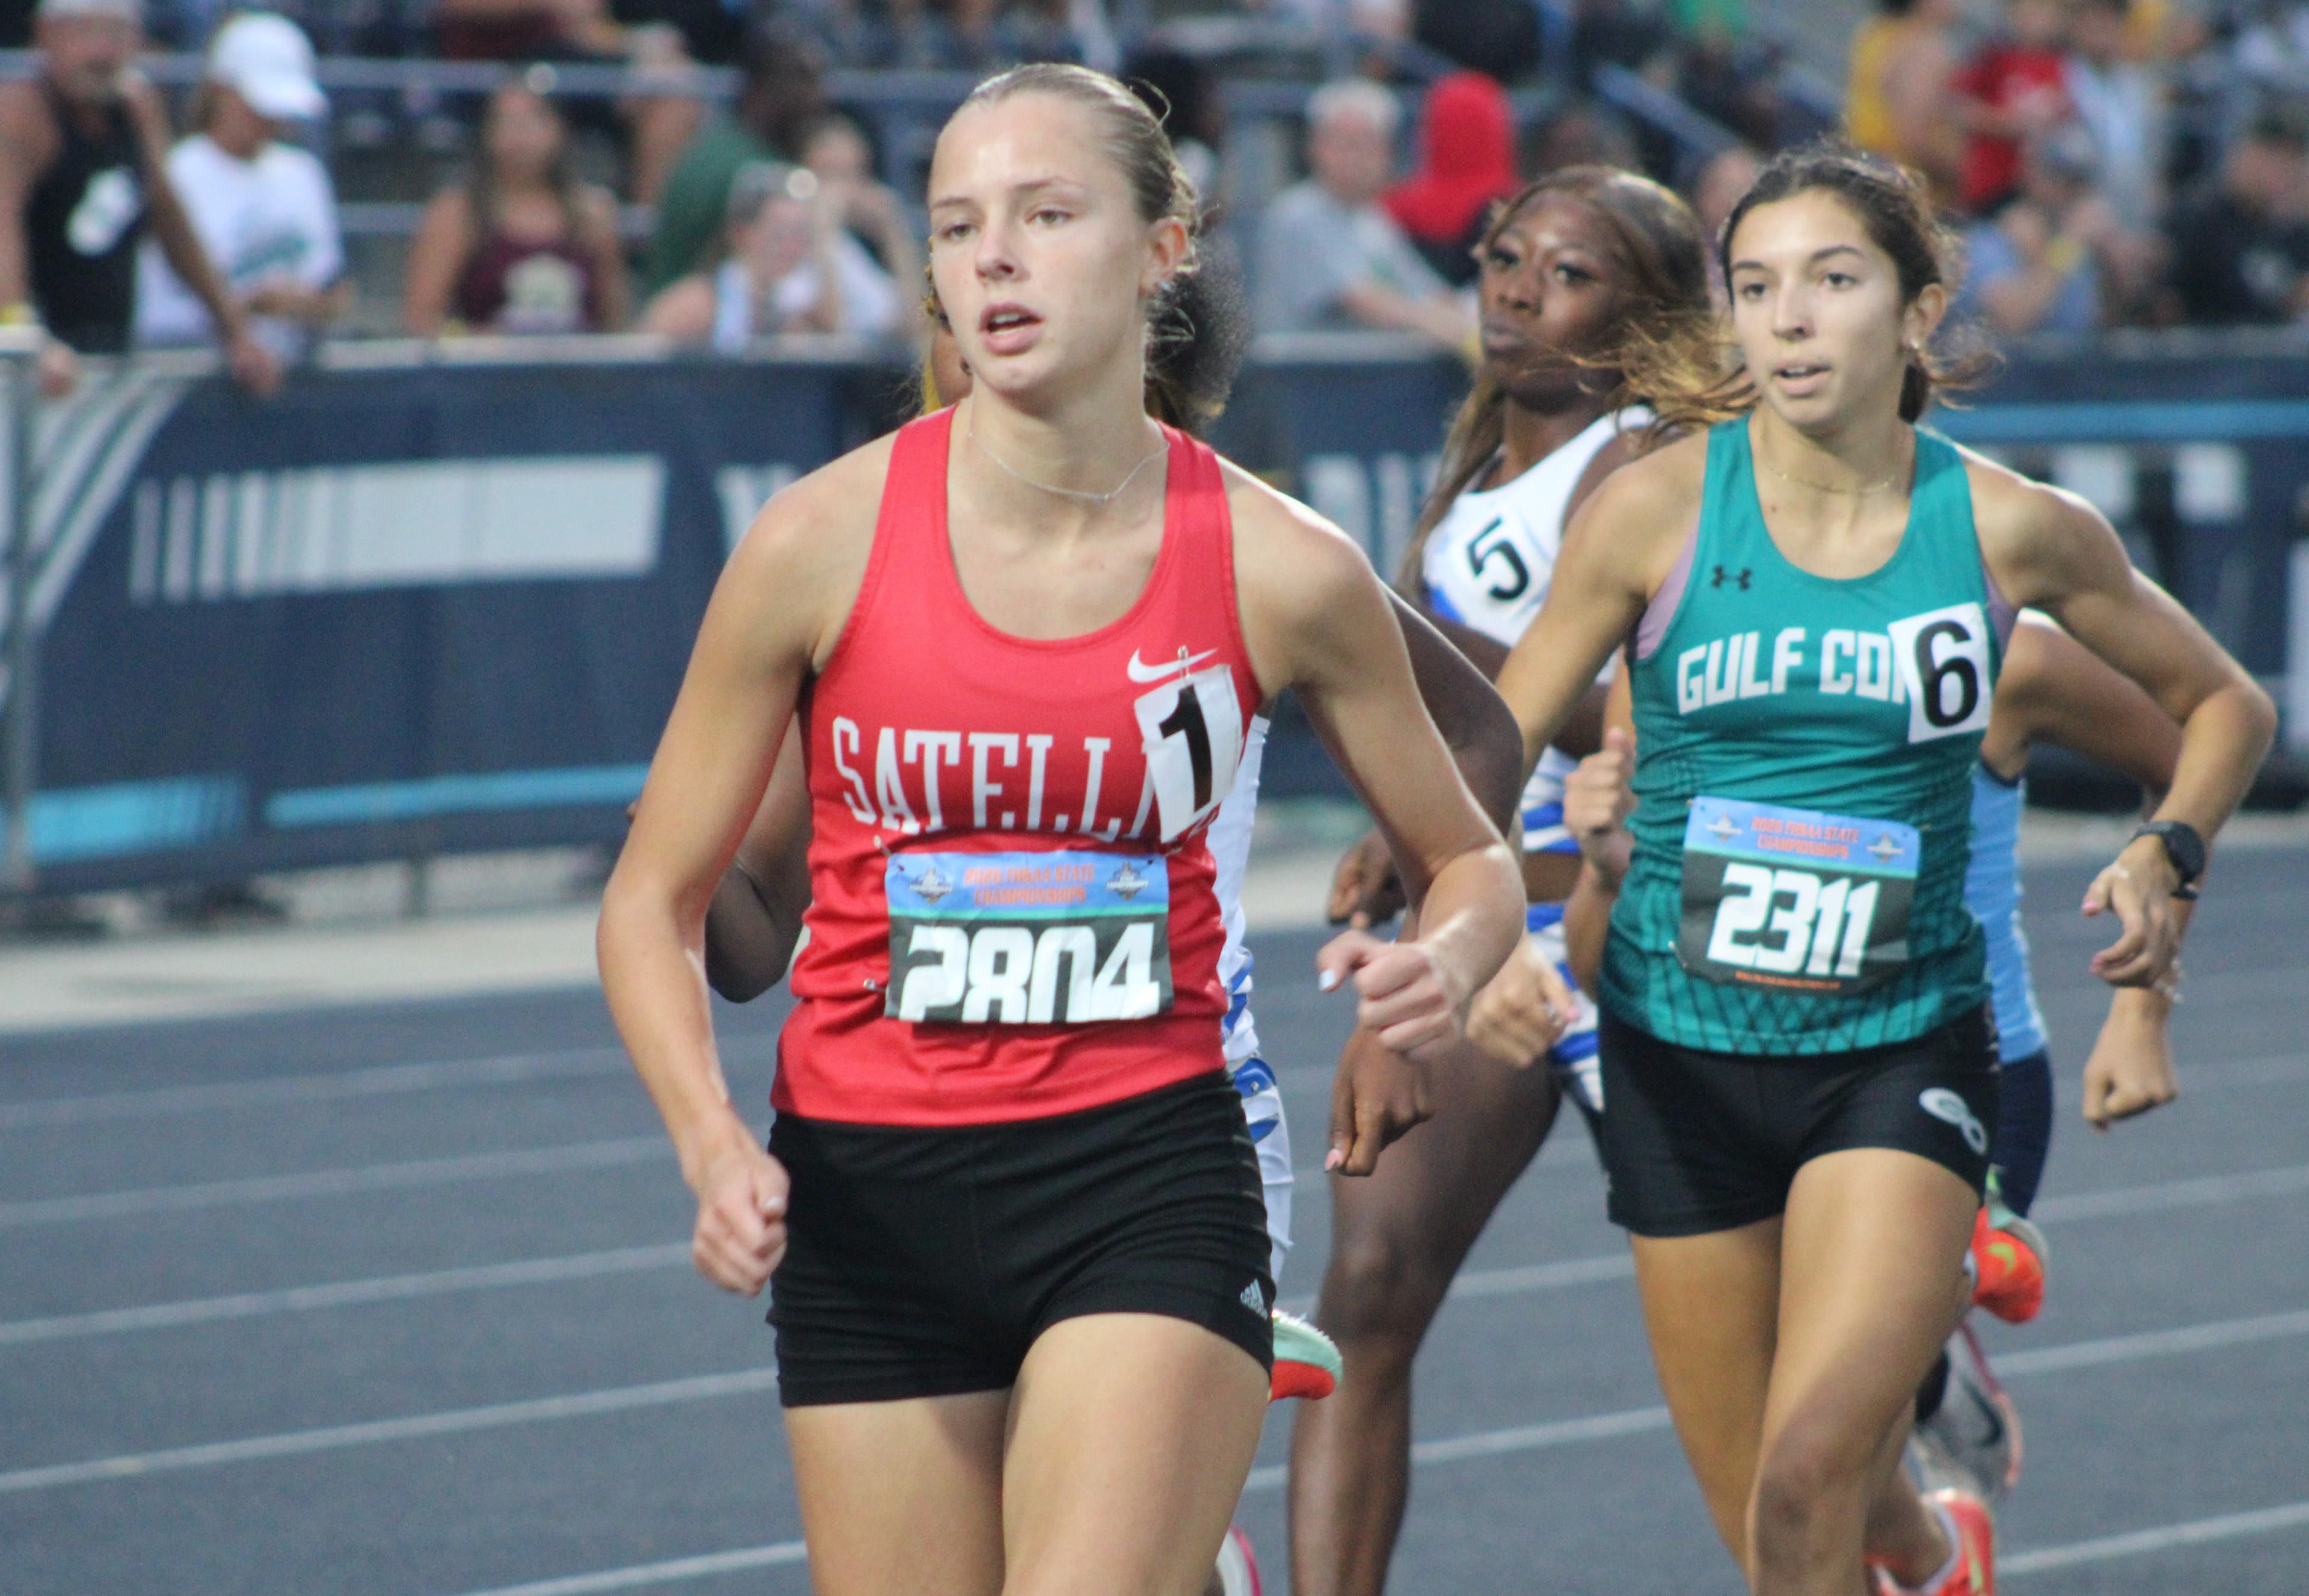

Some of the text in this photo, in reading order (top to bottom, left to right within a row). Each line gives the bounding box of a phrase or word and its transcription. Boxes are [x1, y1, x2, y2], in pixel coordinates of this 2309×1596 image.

[1467, 515, 1530, 602] 5
[1677, 626, 1807, 715] GULF
[1915, 619, 1979, 729] 6
[1158, 682, 1213, 814] 1
[974, 886, 1087, 906] CHAMPIONSHIPS
[1706, 861, 1880, 978] 2311
[898, 922, 1161, 1024] 2804
